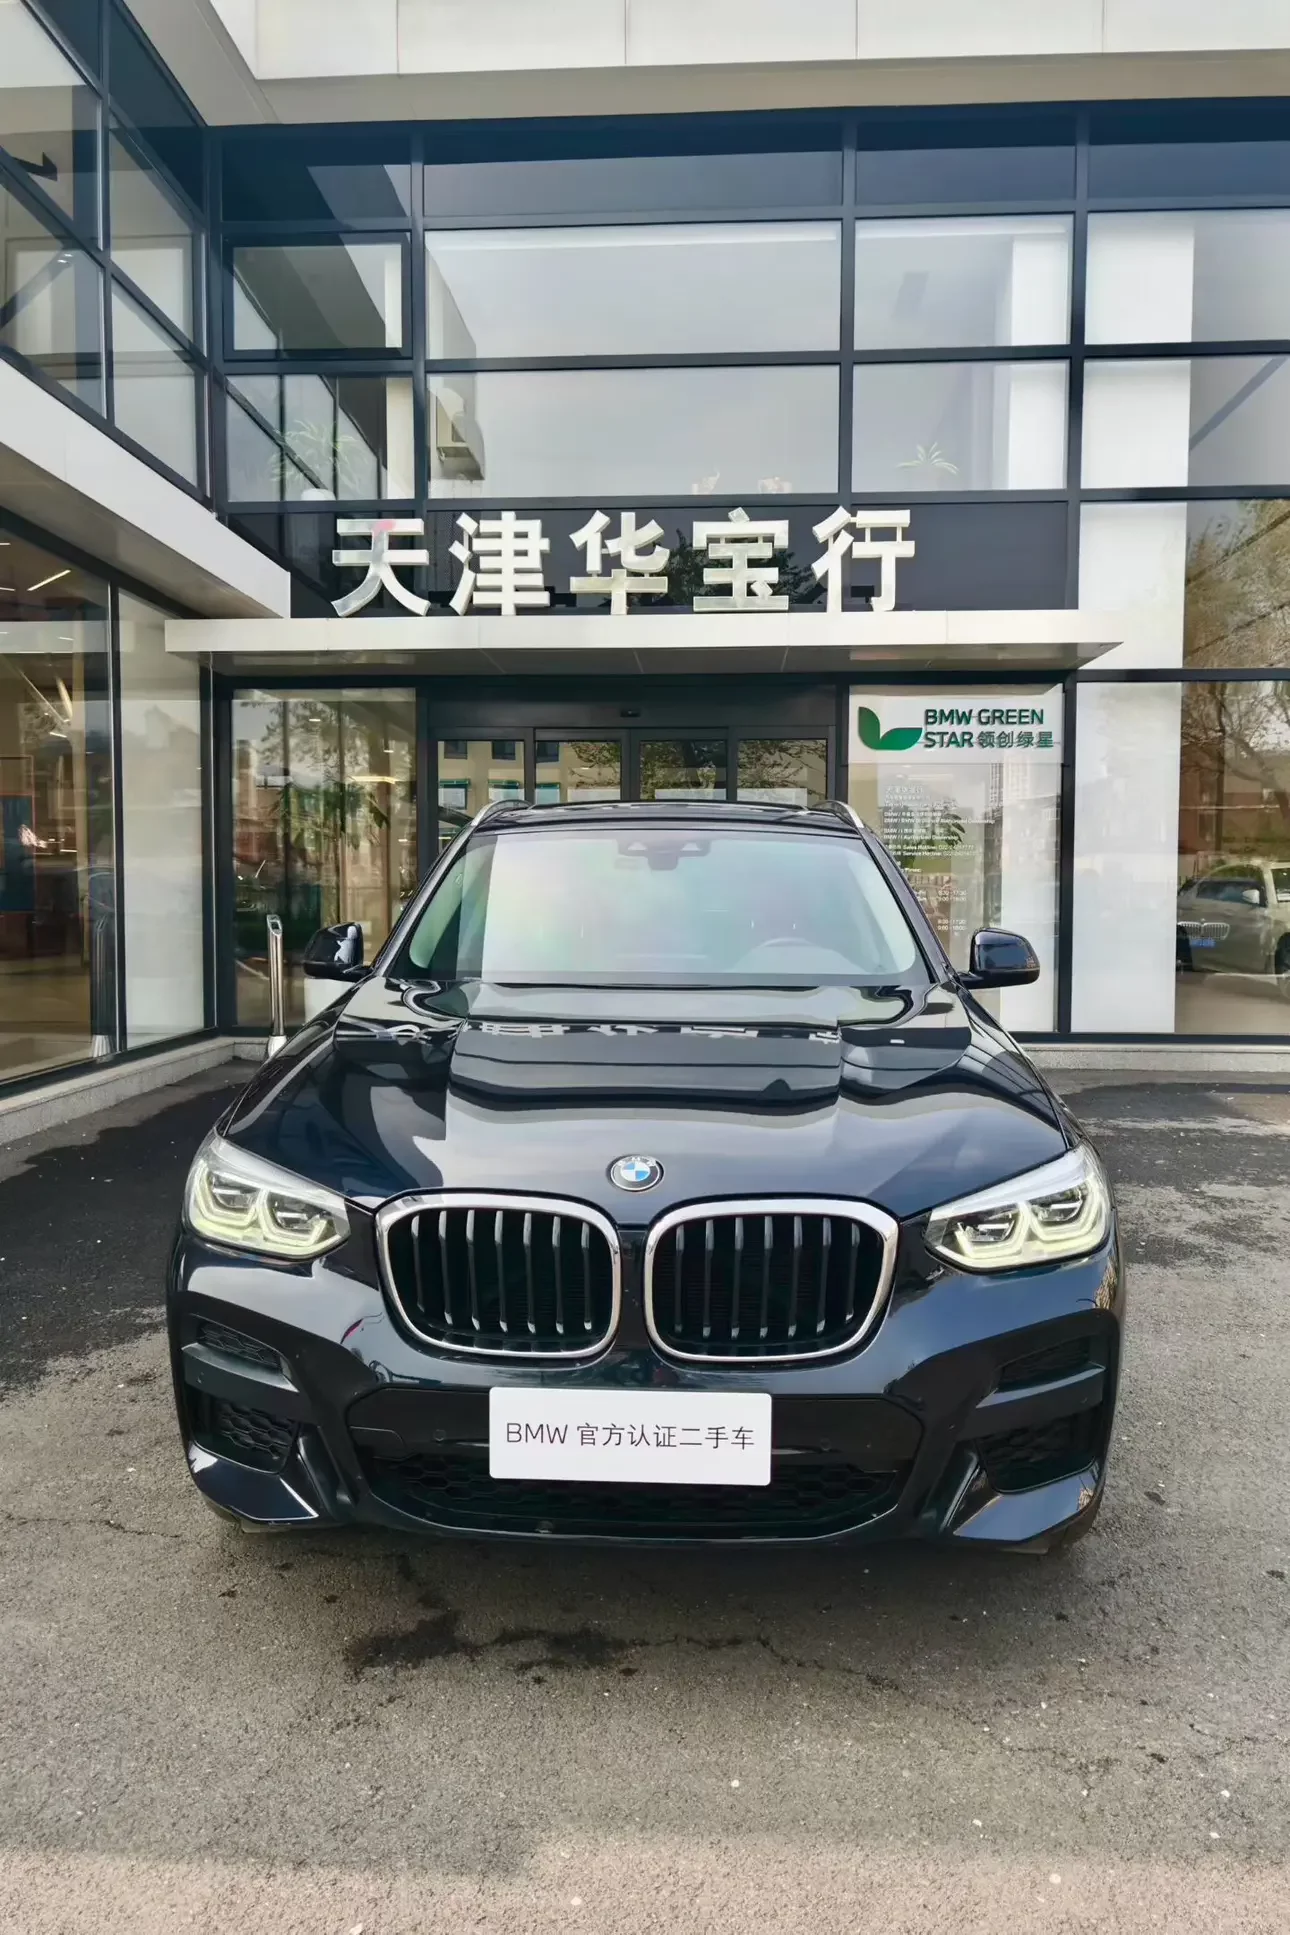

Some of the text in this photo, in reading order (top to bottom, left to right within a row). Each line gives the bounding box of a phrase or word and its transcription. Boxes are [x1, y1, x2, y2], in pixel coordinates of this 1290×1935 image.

[331, 506, 916, 617] 天津华宝行
[925, 708, 1045, 726] BMW GREEN
[924, 731, 1054, 748] STAR 领创绿星
[506, 1422, 755, 1450] BMW 官方认证二手车
